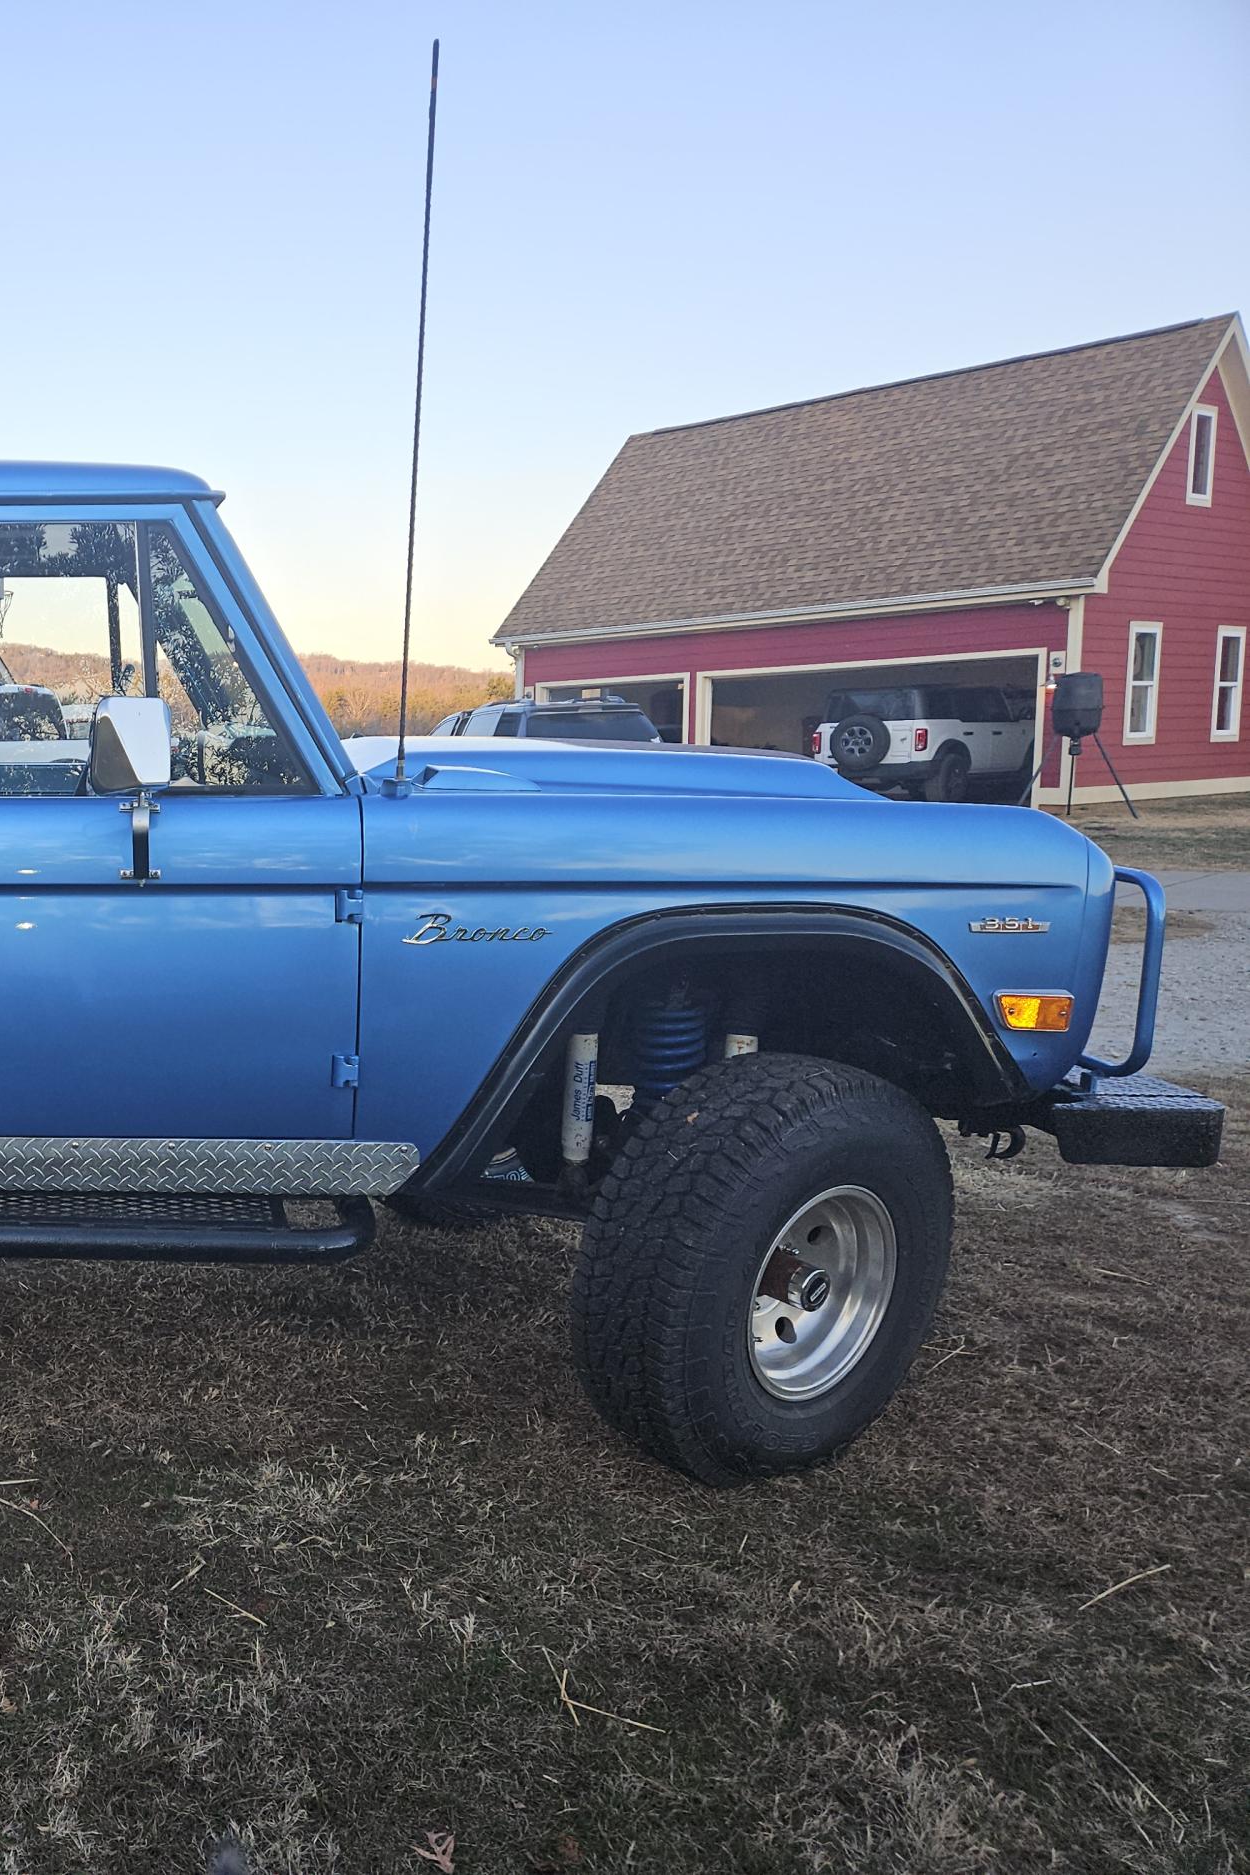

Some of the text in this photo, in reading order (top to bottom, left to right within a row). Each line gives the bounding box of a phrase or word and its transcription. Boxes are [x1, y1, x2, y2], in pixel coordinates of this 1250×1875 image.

[401, 913, 553, 945] Bronco
[982, 917, 1034, 930] 351
[571, 1060, 584, 1121] James Duff
